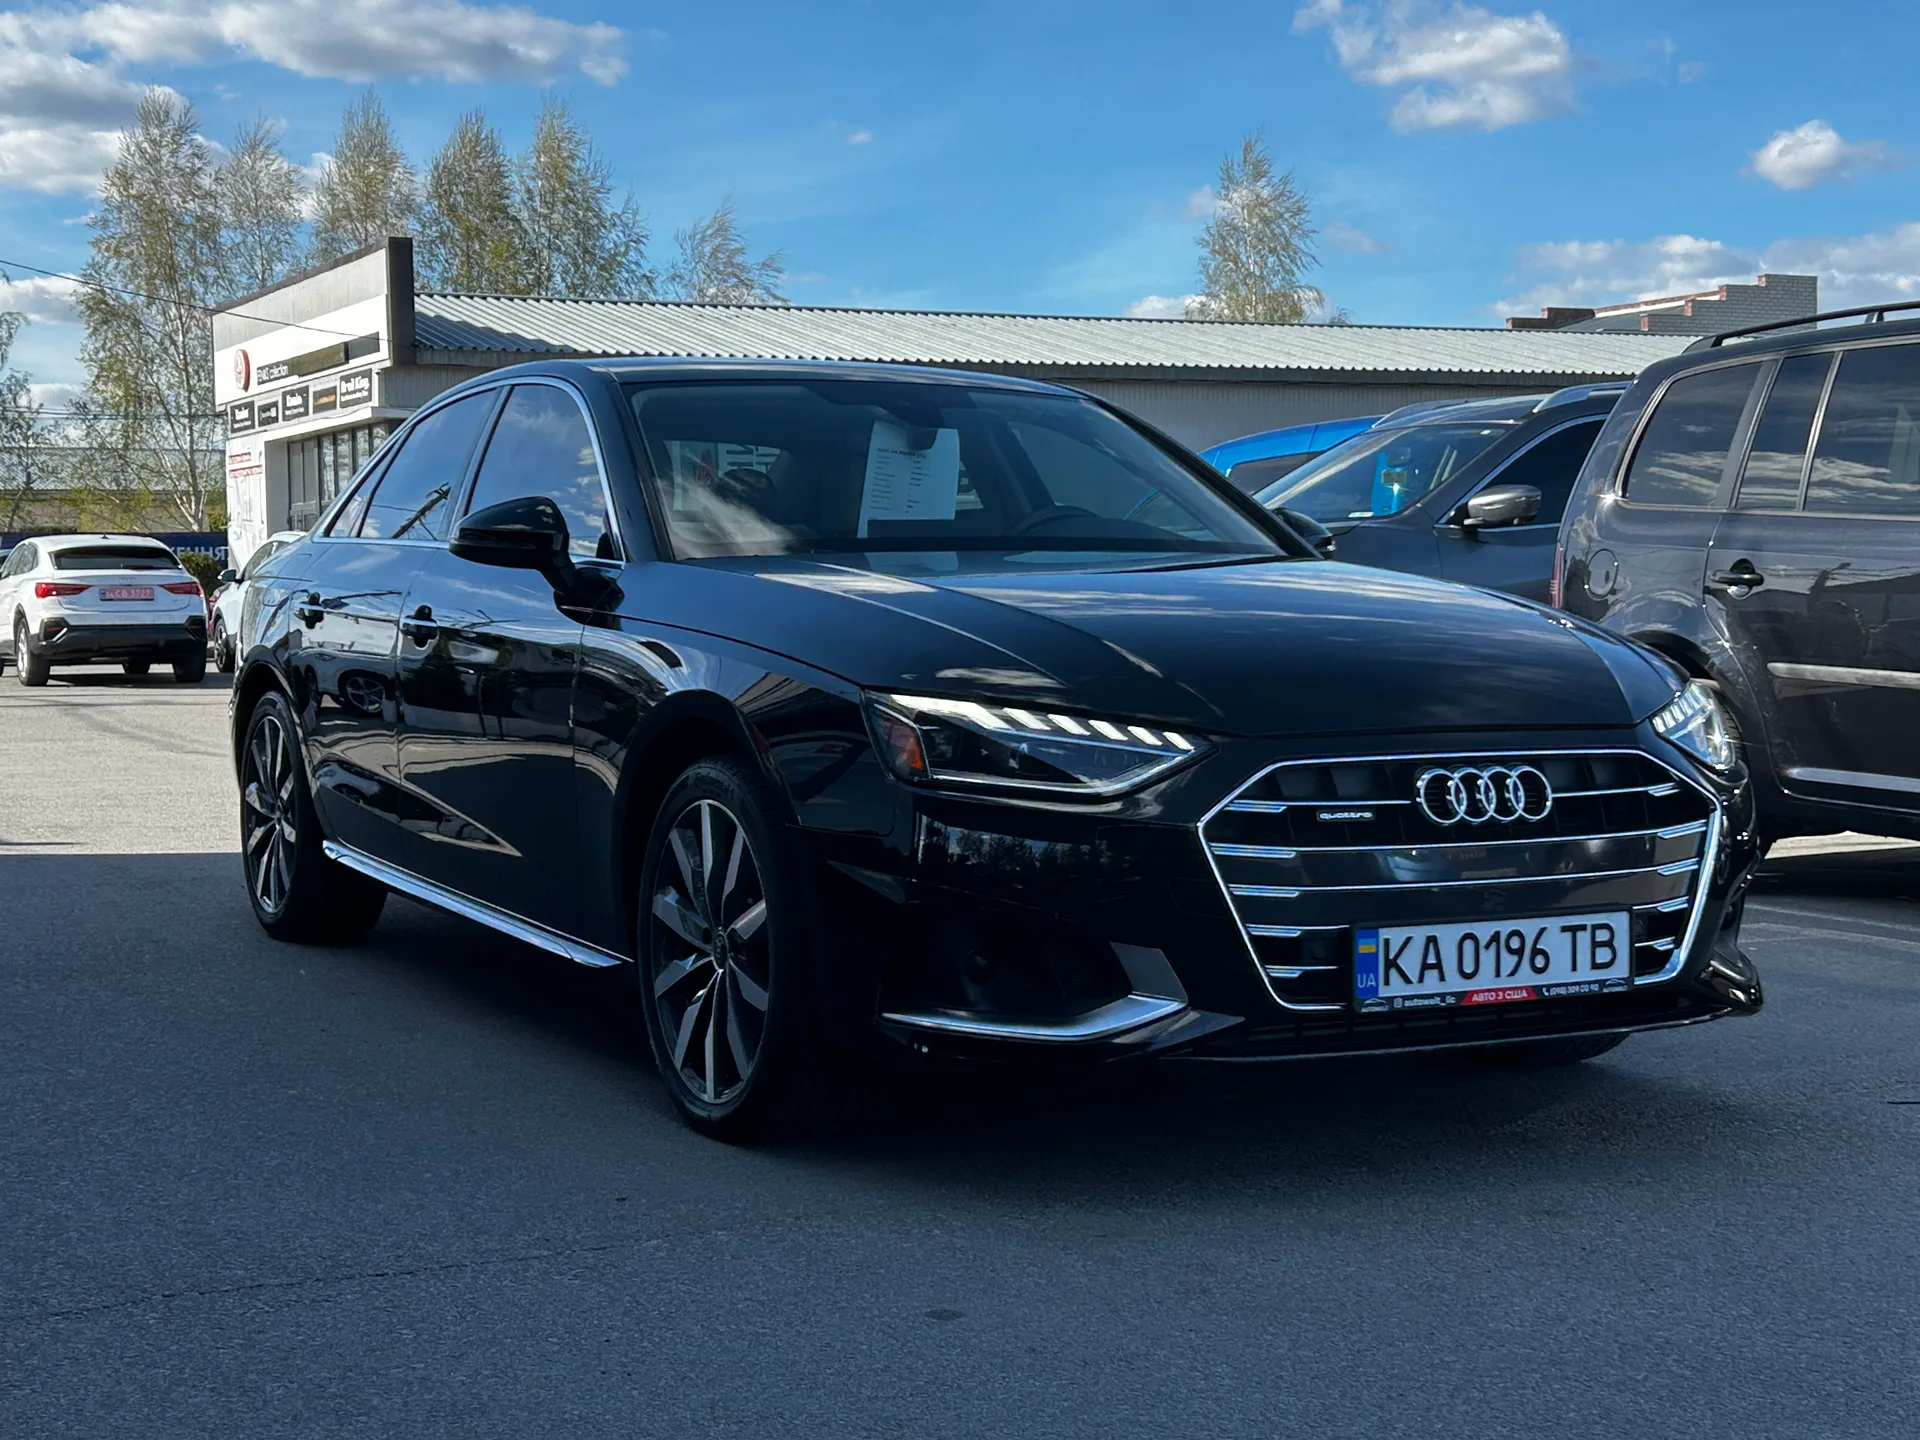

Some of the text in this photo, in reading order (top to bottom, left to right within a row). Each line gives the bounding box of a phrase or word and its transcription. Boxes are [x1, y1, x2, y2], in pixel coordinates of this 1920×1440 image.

[1319, 811, 1373, 820] quattro
[1383, 923, 1618, 987] KA 0196 TB
[1357, 973, 1377, 989] UA
[1472, 991, 1496, 1002] АВТО
[1505, 989, 1528, 999] США
